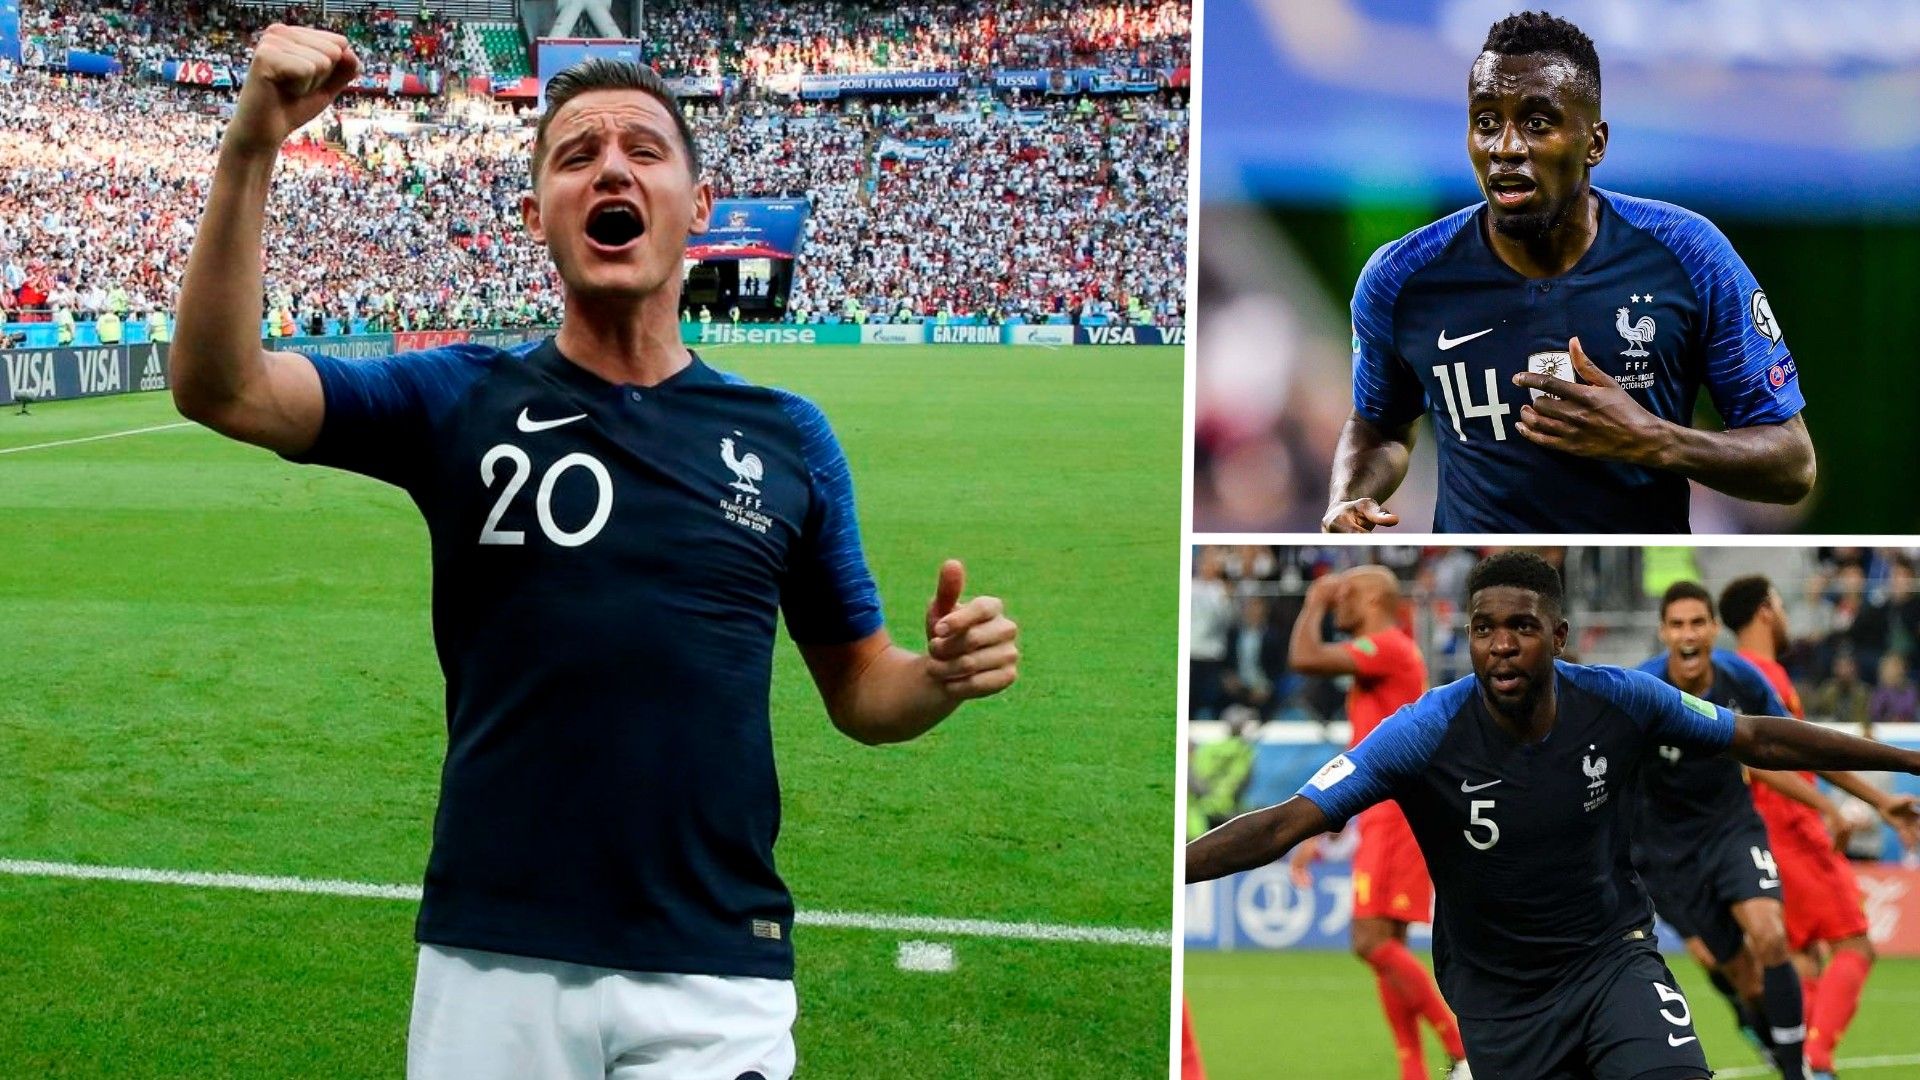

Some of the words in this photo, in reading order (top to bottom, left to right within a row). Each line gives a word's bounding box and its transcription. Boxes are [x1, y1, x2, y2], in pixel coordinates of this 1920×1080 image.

[868, 78, 893, 89] FIFA
[895, 76, 937, 88] WORLD
[701, 323, 816, 344] Hisense
[933, 325, 1000, 343] GAZPROM
[1084, 327, 1136, 345] VISA
[3, 352, 56, 400] VISA
[74, 349, 121, 393] VISA
[140, 375, 166, 391] adidas
[1433, 362, 1510, 441] 14
[479, 444, 613, 547] 20
[1463, 799, 1500, 851] 5
[1749, 846, 1779, 879] 4
[1652, 981, 1692, 1027] 5
